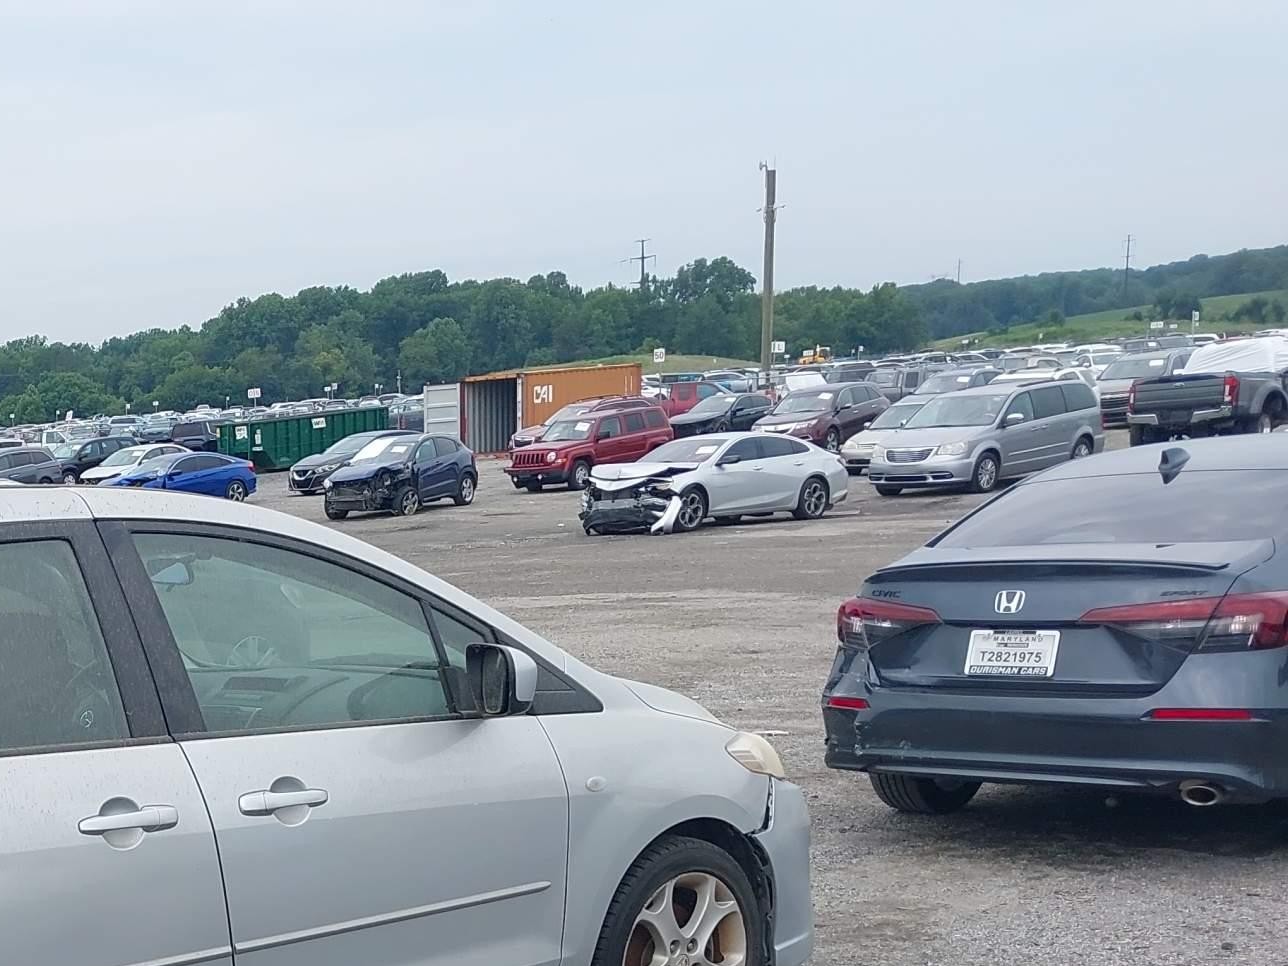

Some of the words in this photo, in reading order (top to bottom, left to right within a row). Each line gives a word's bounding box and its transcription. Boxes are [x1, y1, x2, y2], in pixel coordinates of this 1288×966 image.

[533, 384, 553, 403] CAI
[872, 590, 901, 598] CIVIC
[980, 651, 1042, 663] T2821975
[970, 666, 1019, 675] OURISMAN
[1020, 667, 1047, 675] CARS
